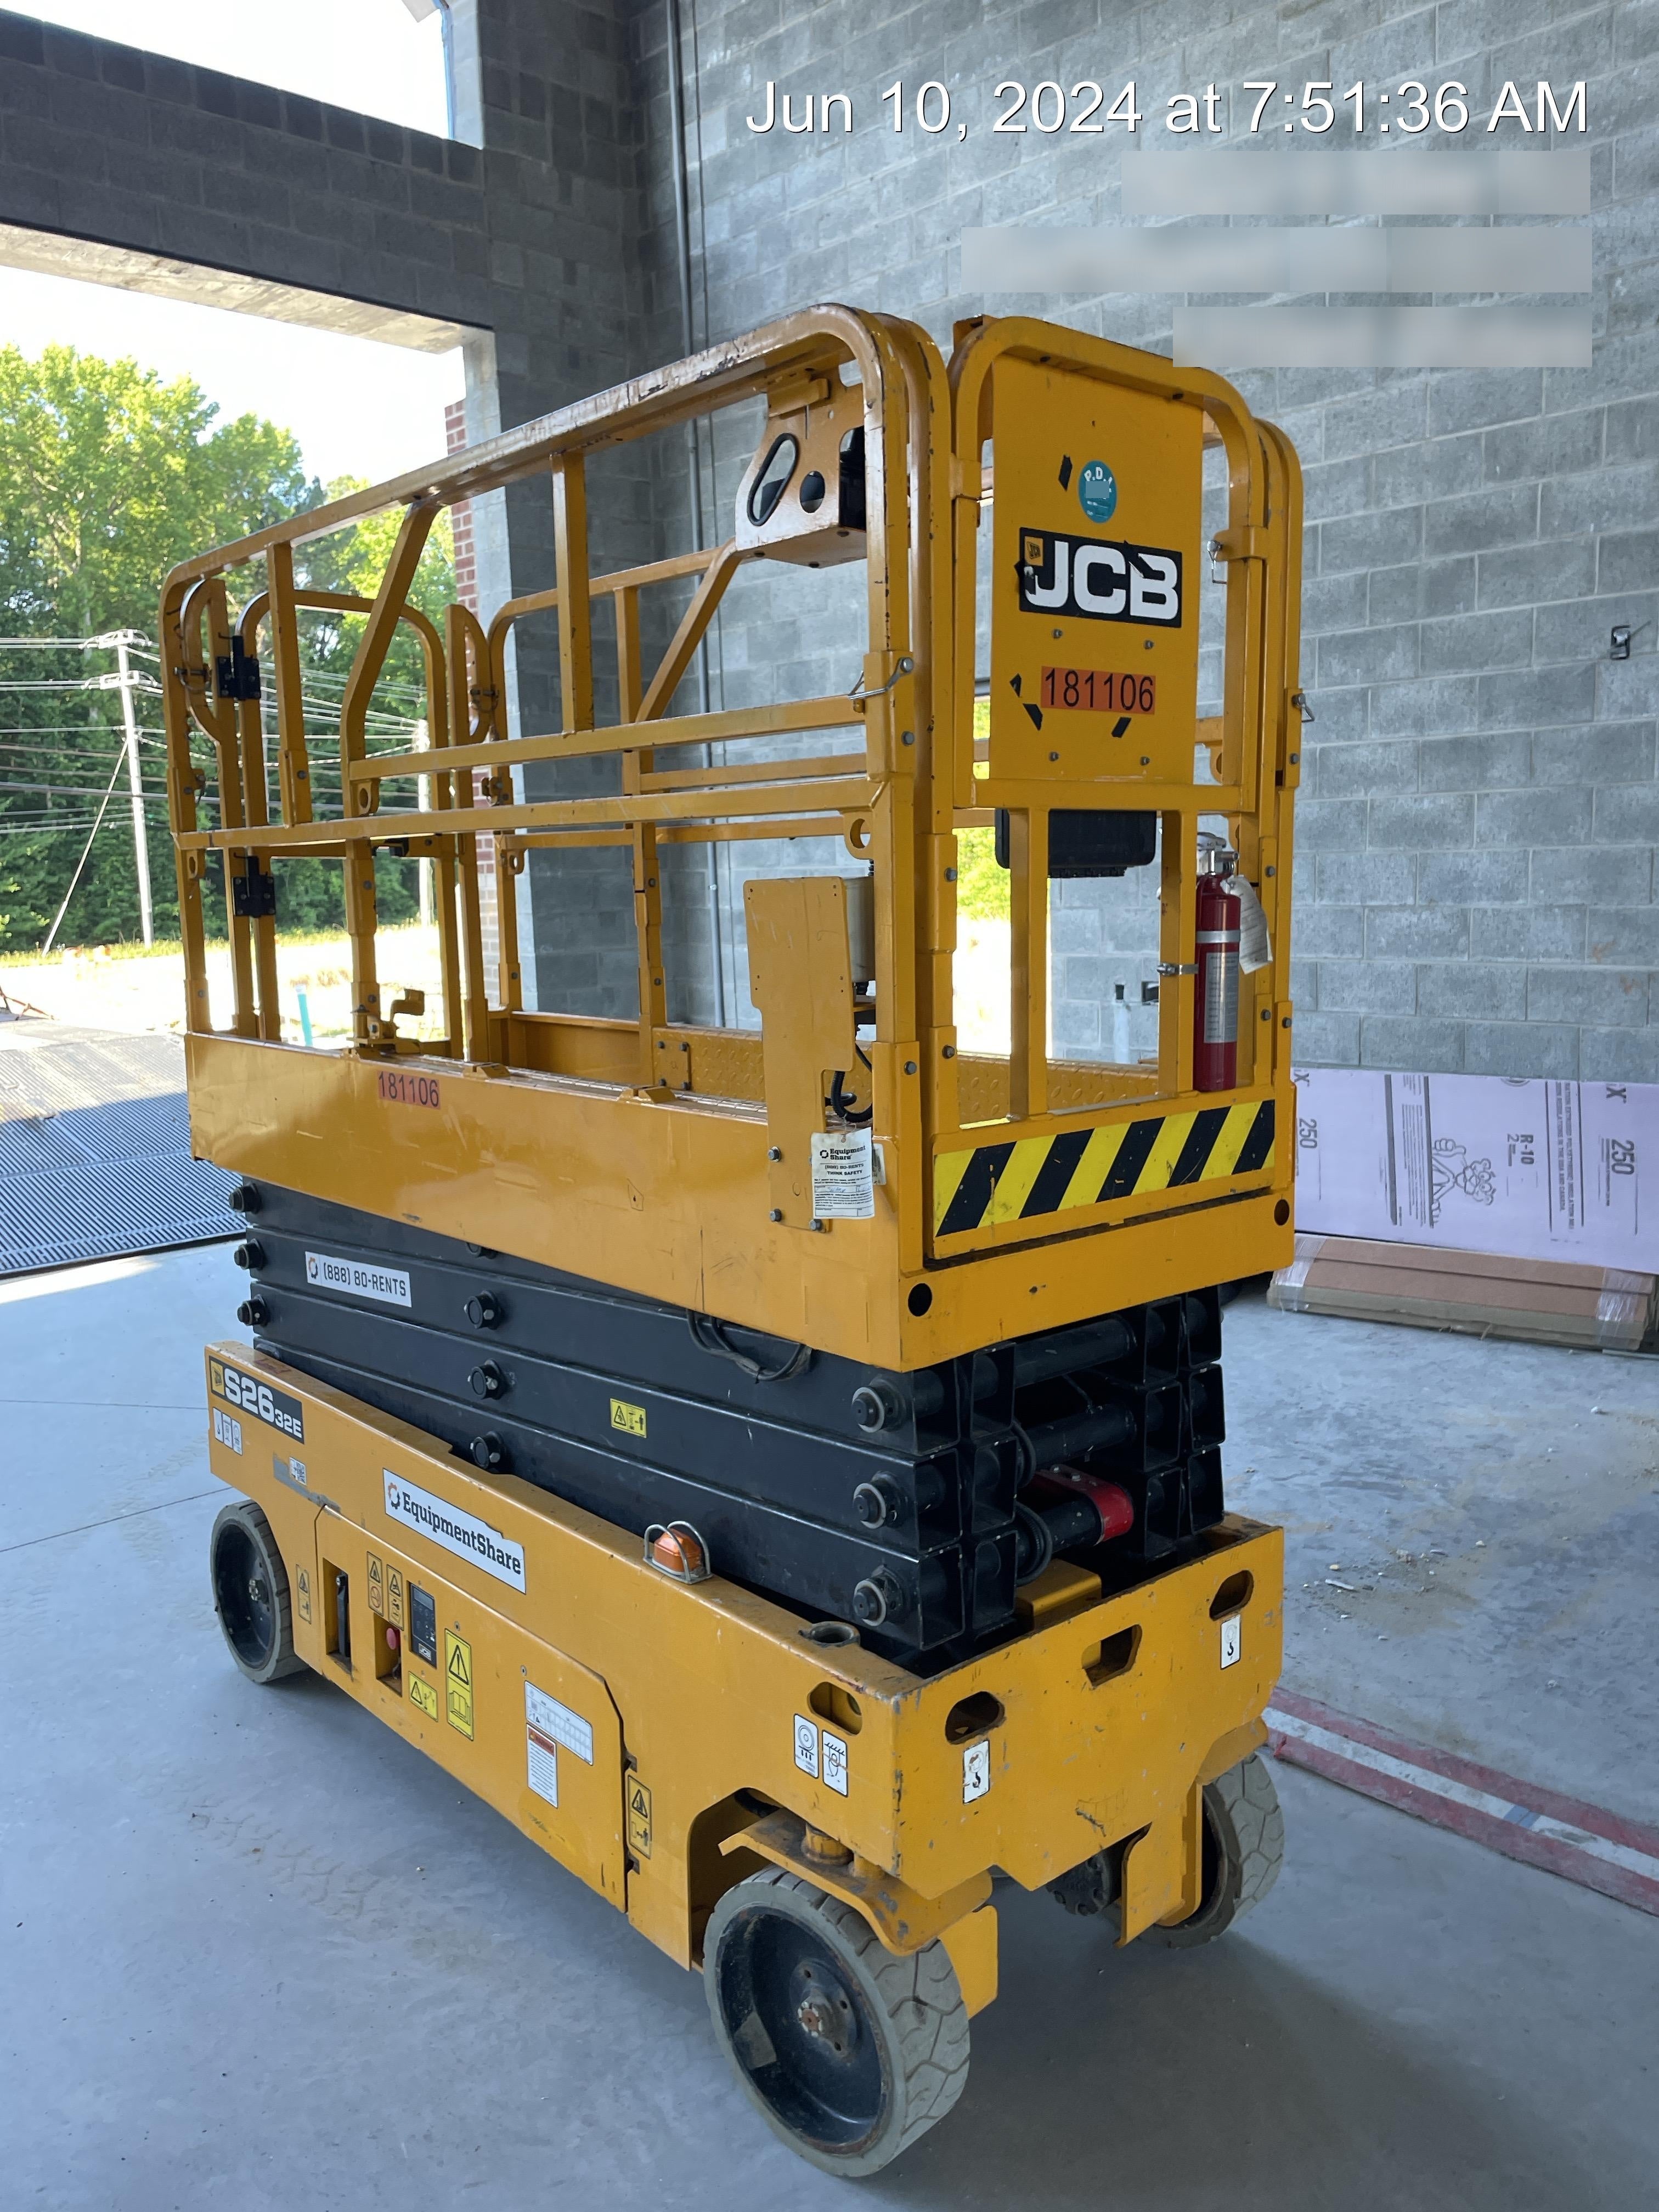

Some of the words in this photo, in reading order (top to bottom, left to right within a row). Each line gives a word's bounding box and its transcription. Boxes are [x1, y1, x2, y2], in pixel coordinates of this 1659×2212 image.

[1024, 540, 1179, 620] JCB
[1045, 668, 1153, 712] 181106
[379, 1071, 439, 1107] 181106
[830, 1146, 866, 1155] Equipment
[1299, 1118, 1318, 1149] 250
[1520, 1134, 1534, 1165] R-10
[1611, 1138, 1635, 1176] 250
[324, 1262, 351, 1285] (888)
[354, 1271, 406, 1296] 80-RENTS
[402, 1492, 521, 1575] EquipmentShare
